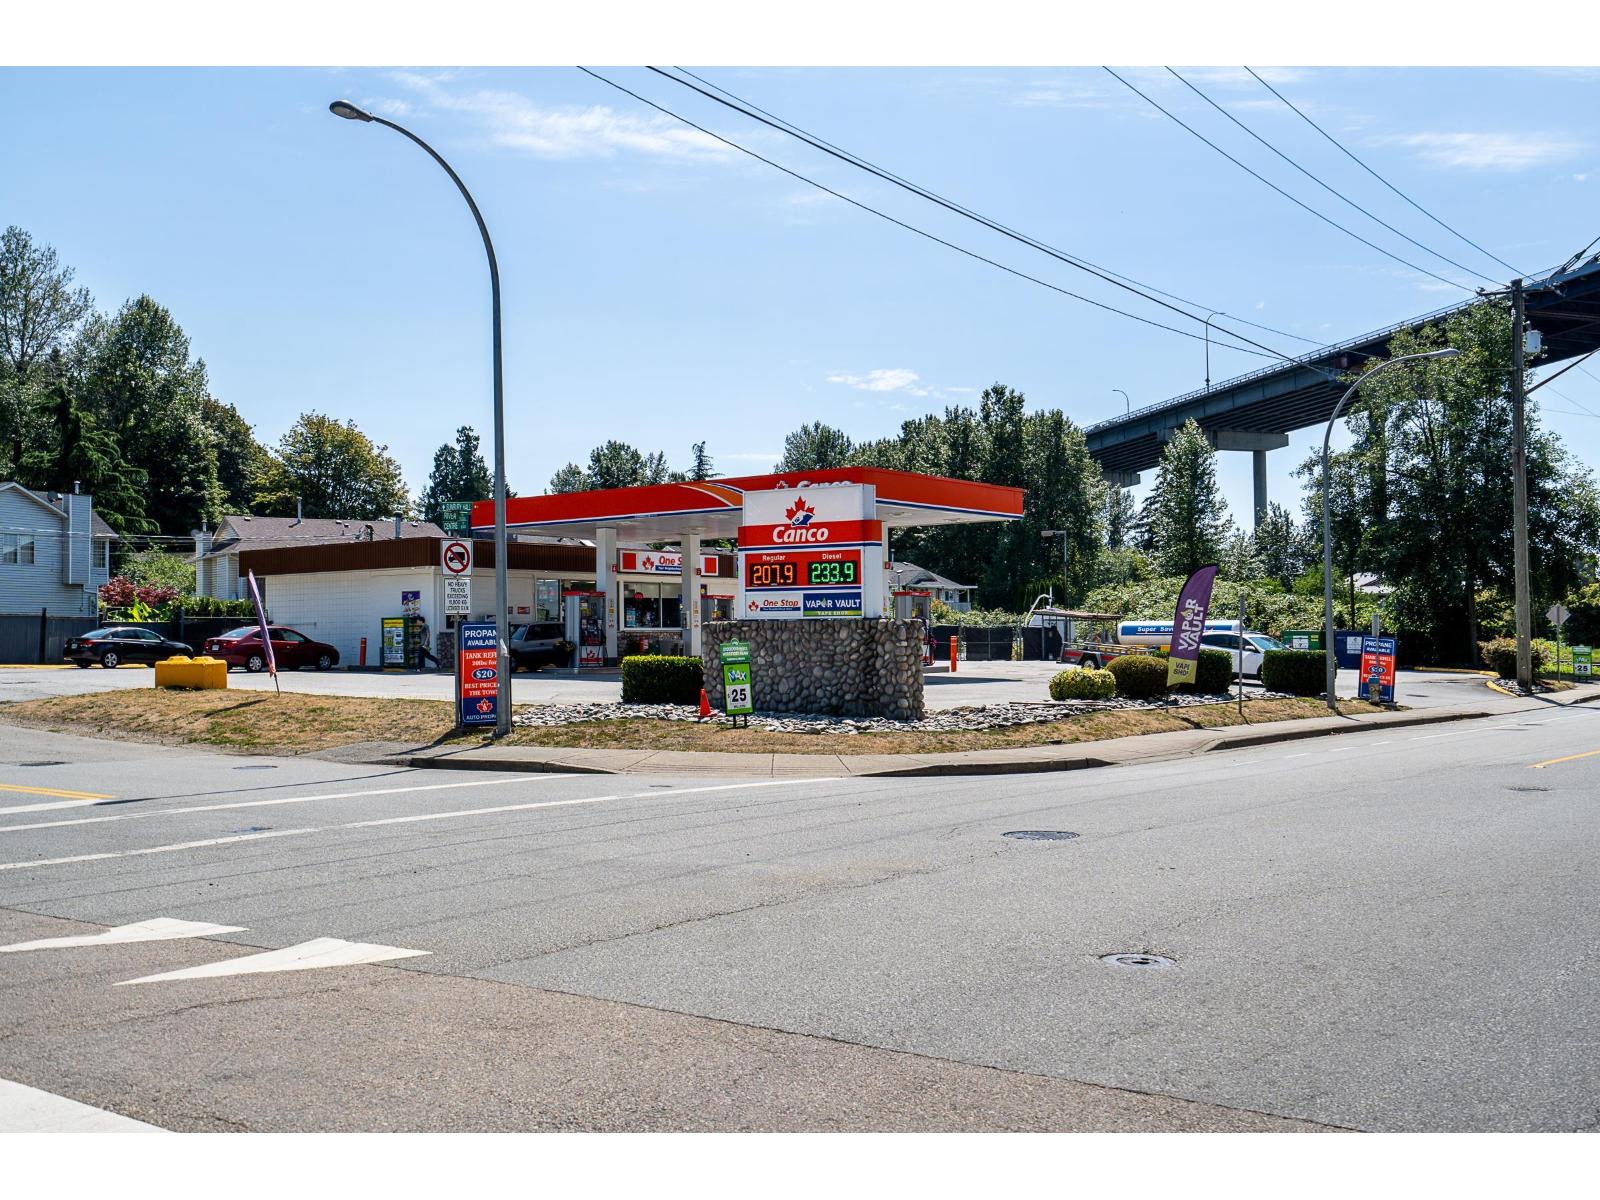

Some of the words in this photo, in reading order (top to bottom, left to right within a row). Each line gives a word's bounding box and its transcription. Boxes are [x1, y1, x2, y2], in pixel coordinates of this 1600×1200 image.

[772, 527, 828, 542] Canco
[659, 556, 676, 565] One
[762, 554, 786, 562] Regular
[753, 565, 793, 584] 207.9
[812, 562, 854, 582] 233.9
[781, 599, 798, 608] Stop
[1178, 598, 1196, 650] VAPOR
[1188, 604, 1204, 651] VAULT
[465, 630, 497, 638] PROPAN
[476, 670, 493, 678] $20
